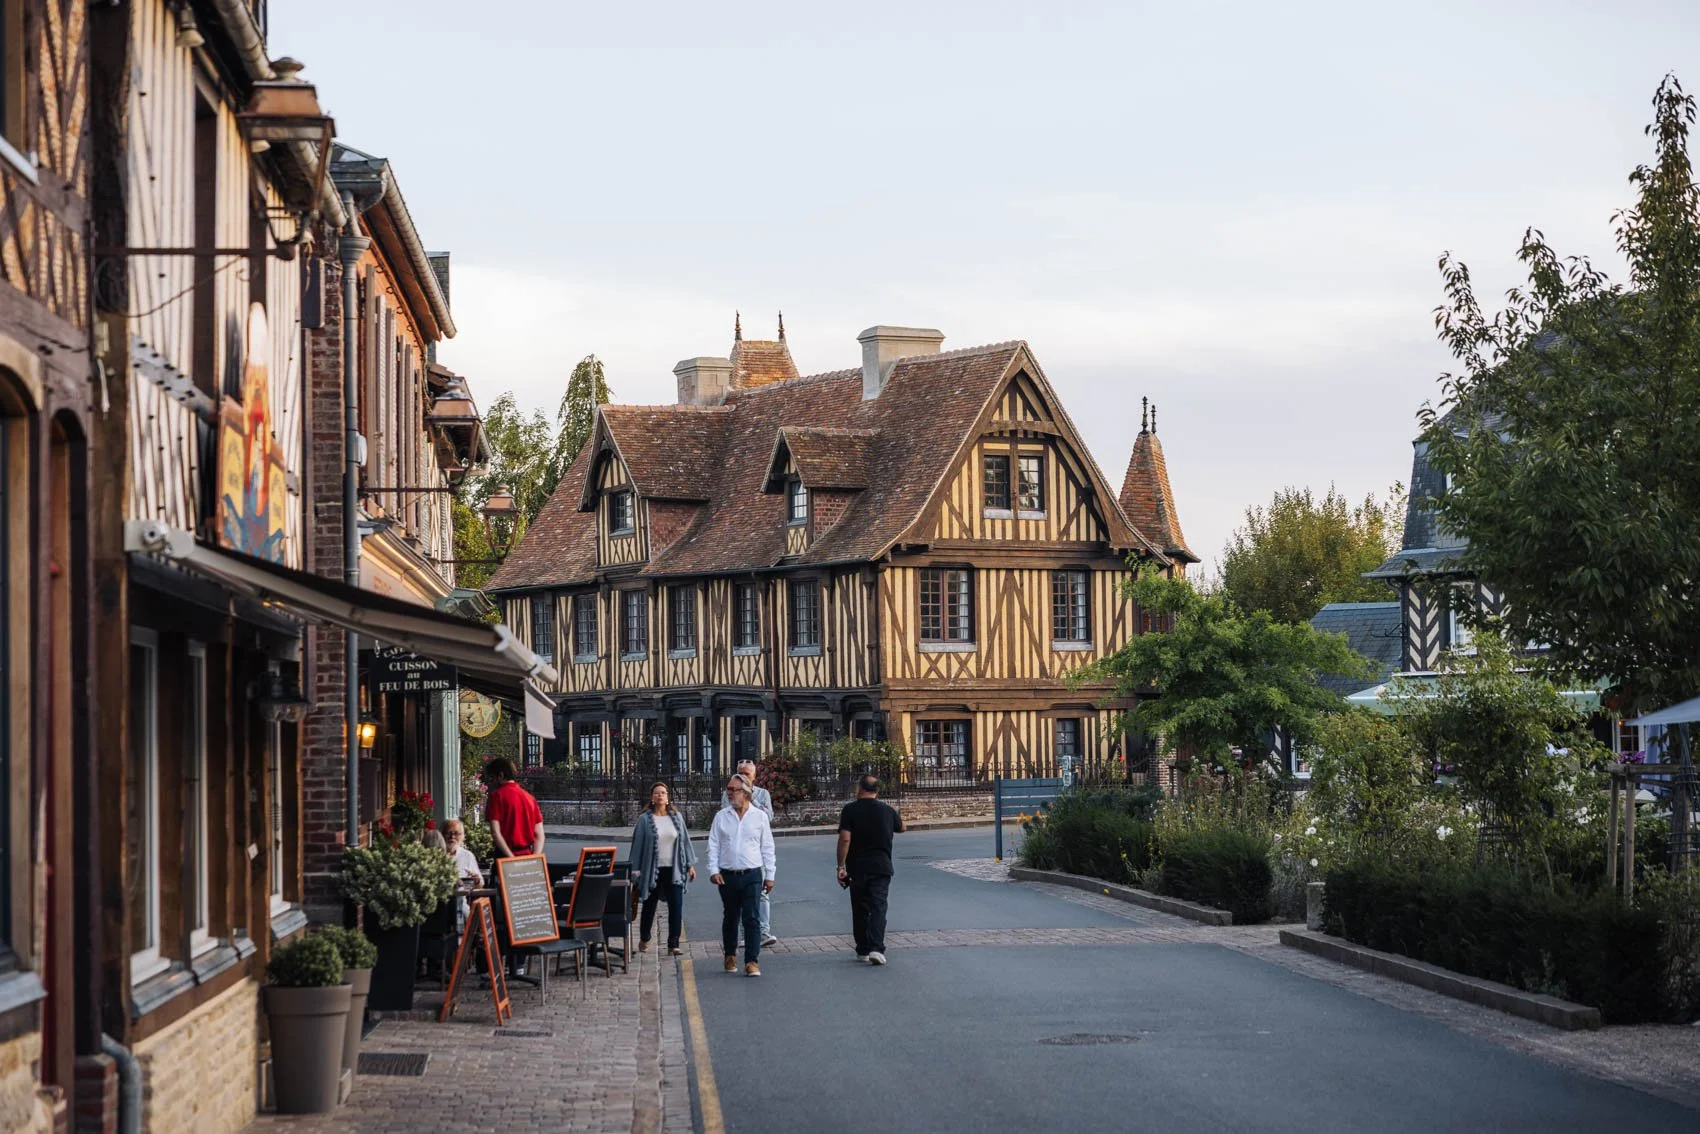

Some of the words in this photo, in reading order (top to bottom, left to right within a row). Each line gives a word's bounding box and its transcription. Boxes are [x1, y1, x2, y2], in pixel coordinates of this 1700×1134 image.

[388, 660, 438, 672] CUISSON
[379, 681, 401, 691] FEU
[404, 680, 420, 690] DE
[423, 679, 450, 690] BOIS
